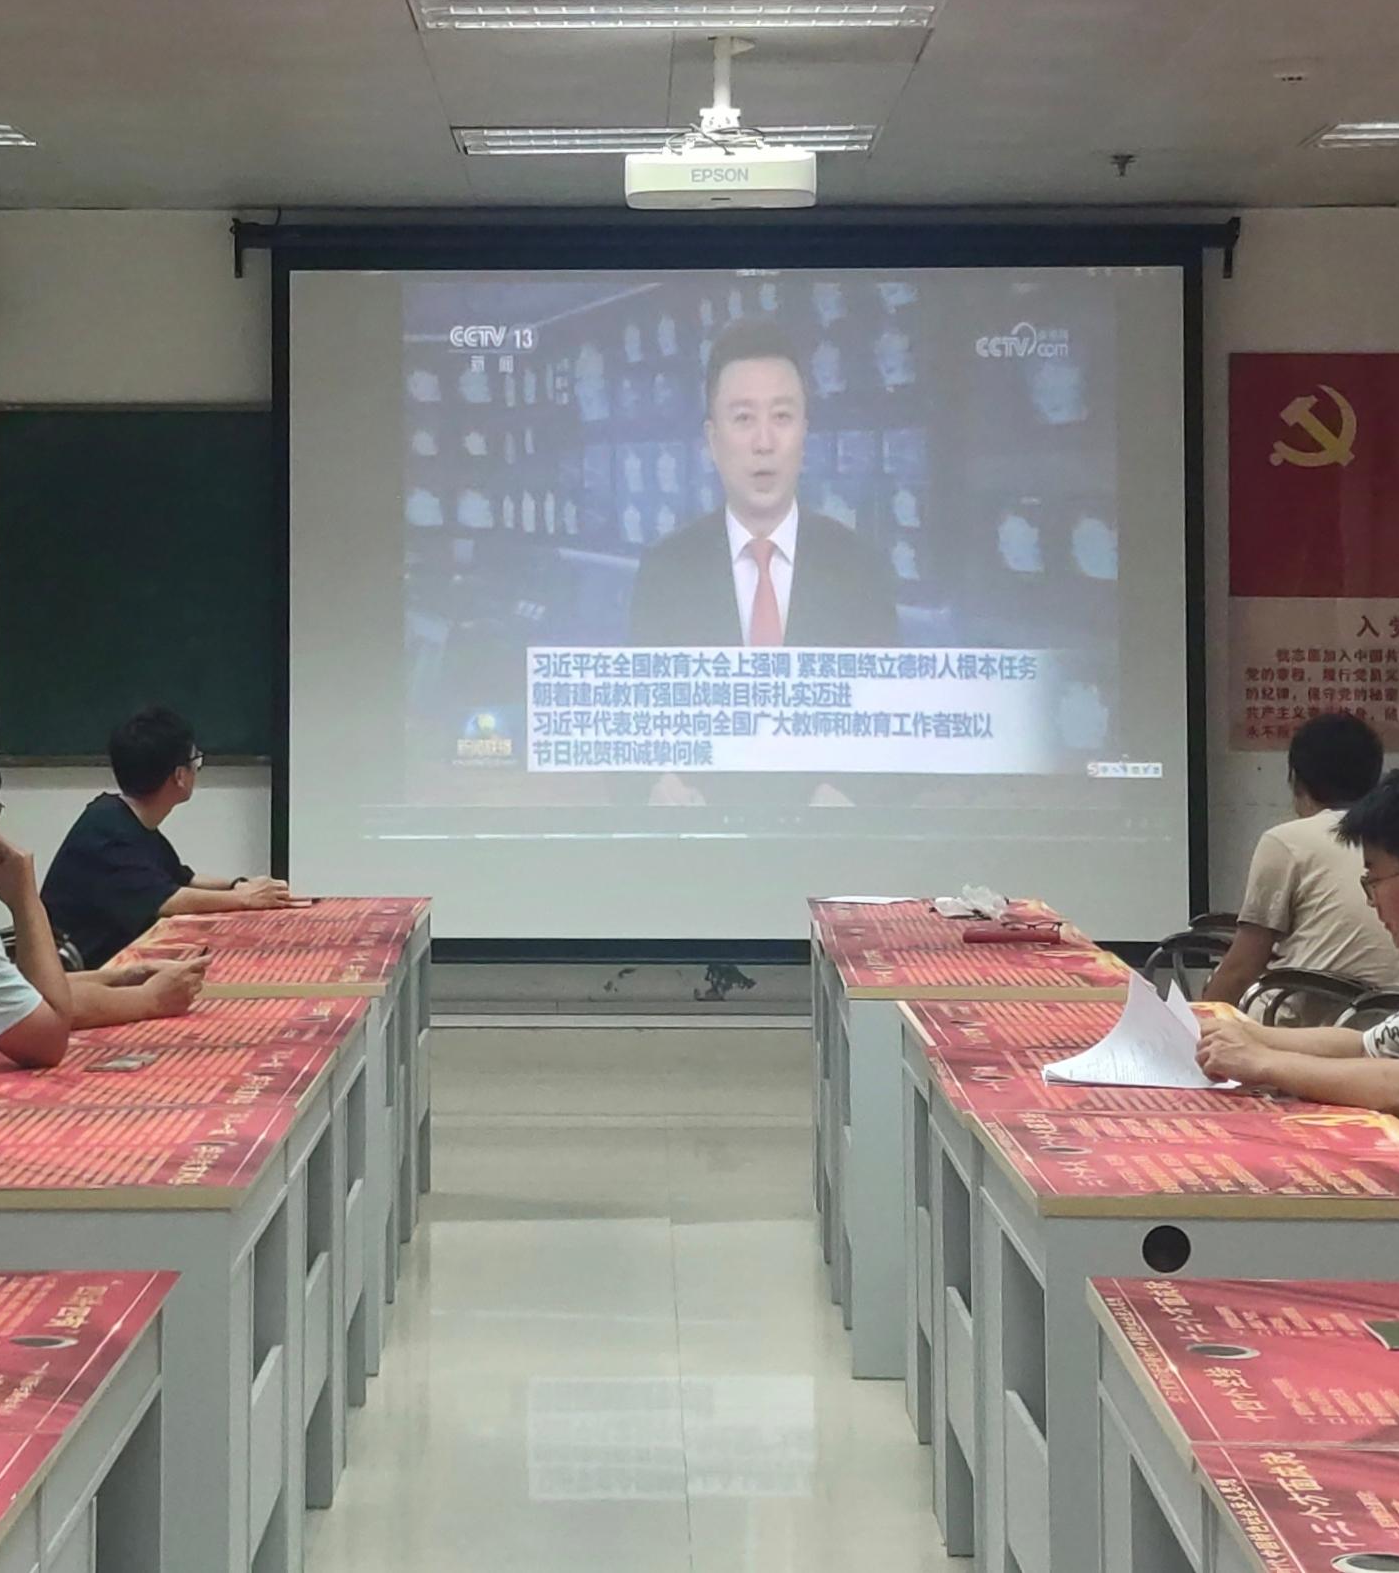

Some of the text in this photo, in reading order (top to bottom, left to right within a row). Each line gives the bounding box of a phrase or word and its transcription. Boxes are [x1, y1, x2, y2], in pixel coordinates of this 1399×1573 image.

[690, 168, 749, 183] EPSON
[450, 325, 533, 349] CCTV 13
[975, 336, 1031, 358] CCTV
[532, 653, 1038, 680] 习近平在全国教育大会上强调 紧紧围绕立德树人根本任务
[532, 682, 852, 709] 朝着建成教育强国战略目标扎实迈进
[532, 711, 994, 738] 习近平代表党中央向全国广大教师和教育工作者致以
[532, 740, 714, 767] 节日祝贺和诚挚问候
[1203, 1366, 1277, 1423] 十四个坚持
[1259, 1451, 1367, 1551] 十三个方面成就
